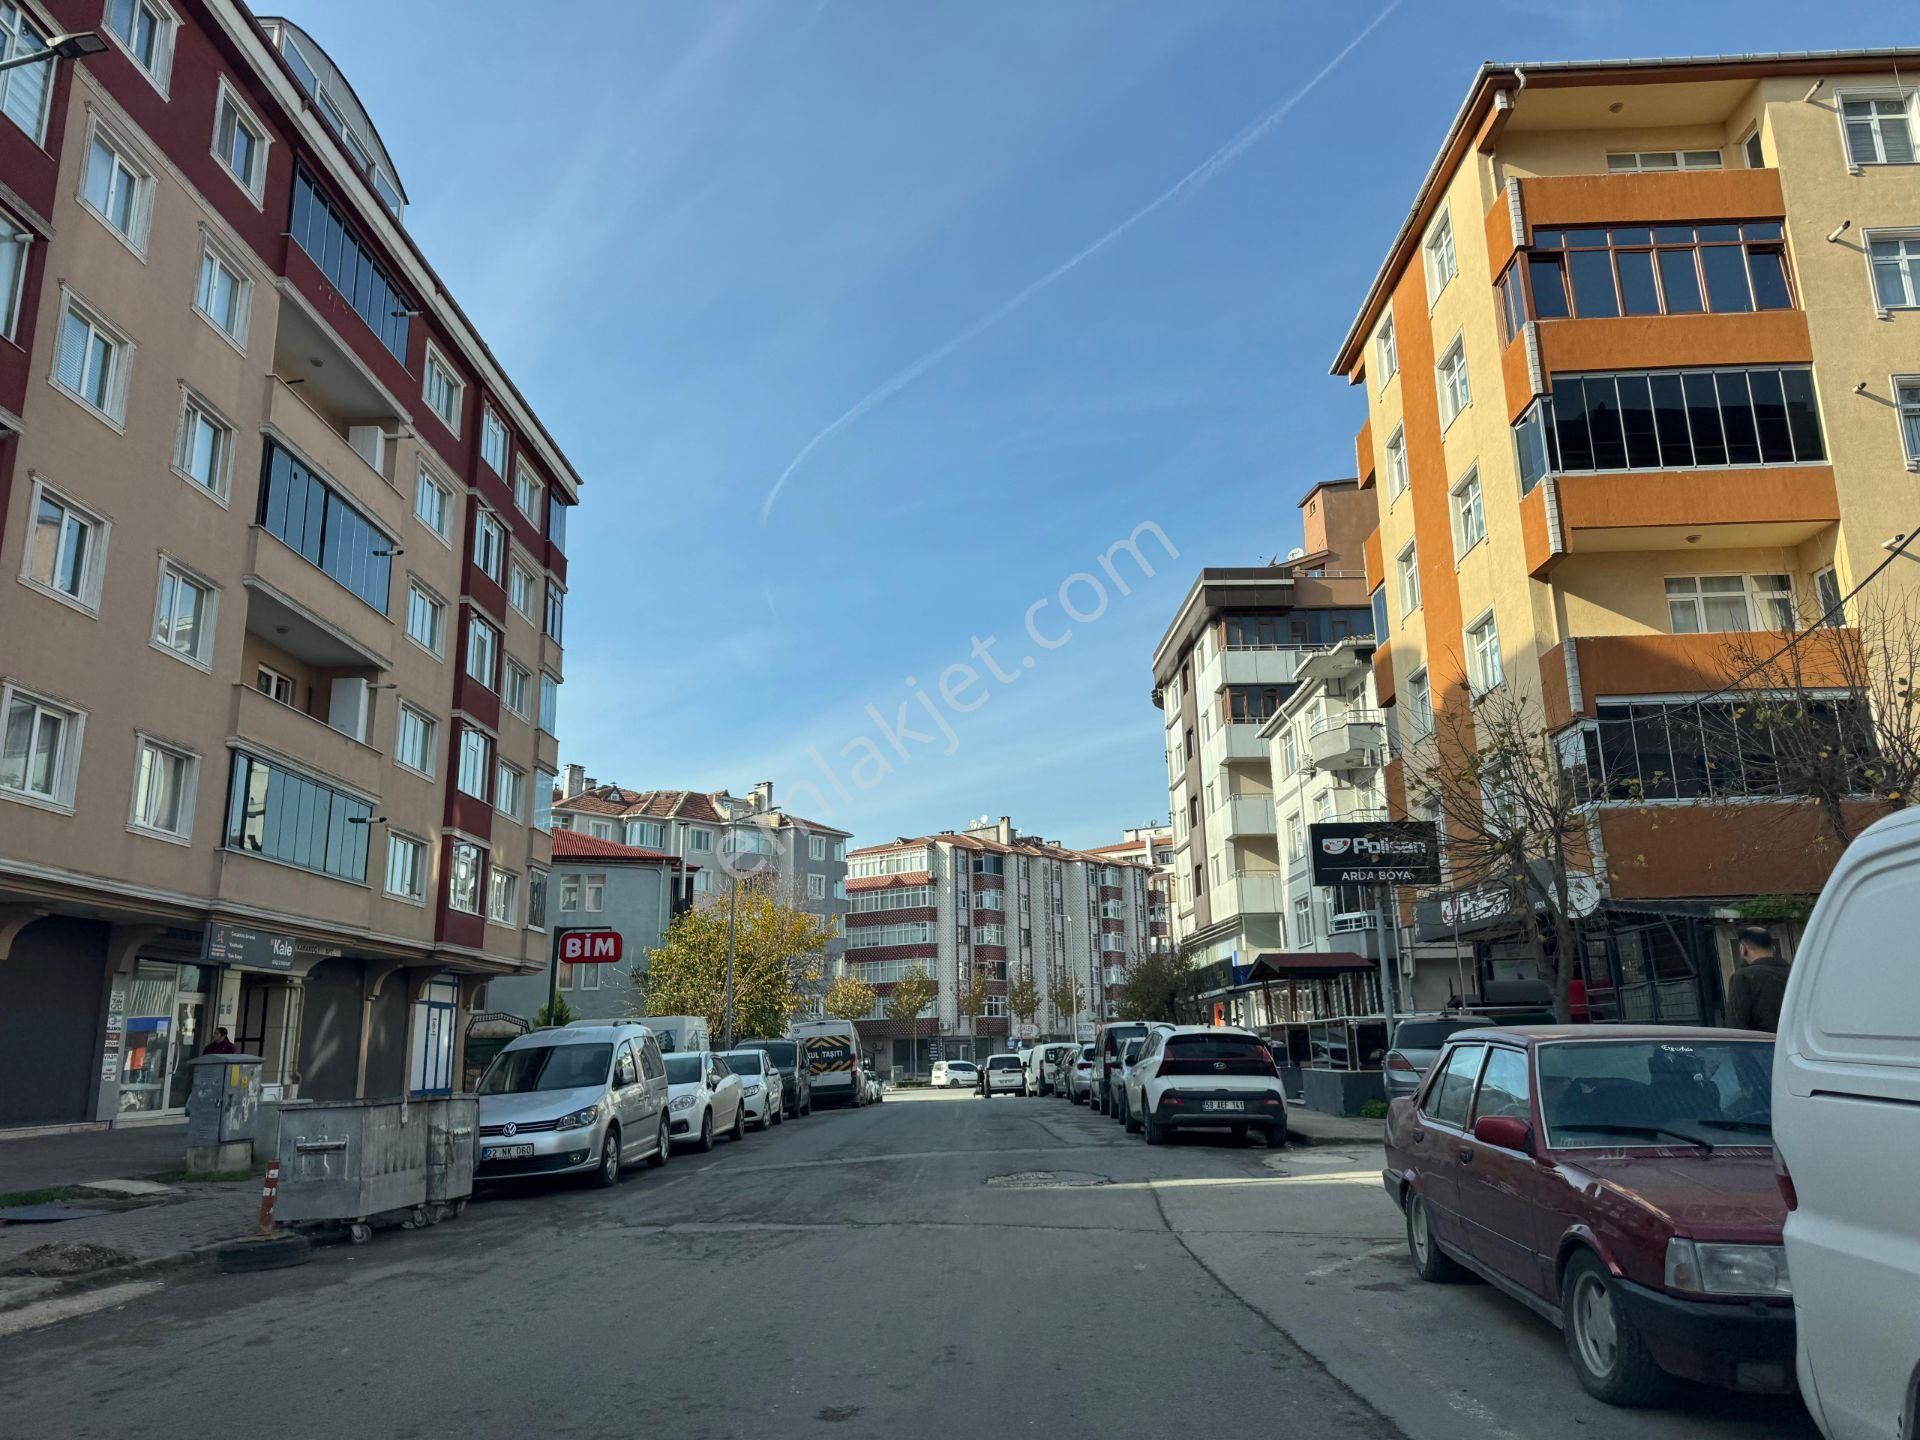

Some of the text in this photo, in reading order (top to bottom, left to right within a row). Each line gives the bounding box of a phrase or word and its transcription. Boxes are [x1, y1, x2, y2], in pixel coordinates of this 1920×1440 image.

[1353, 837, 1426, 854] Polisan
[1341, 870, 1411, 881] ARDA BOYA
[273, 939, 293, 957] Kale
[566, 933, 615, 958] BİM
[822, 1050, 843, 1059] TAŞITI
[487, 1149, 497, 1158] 22
